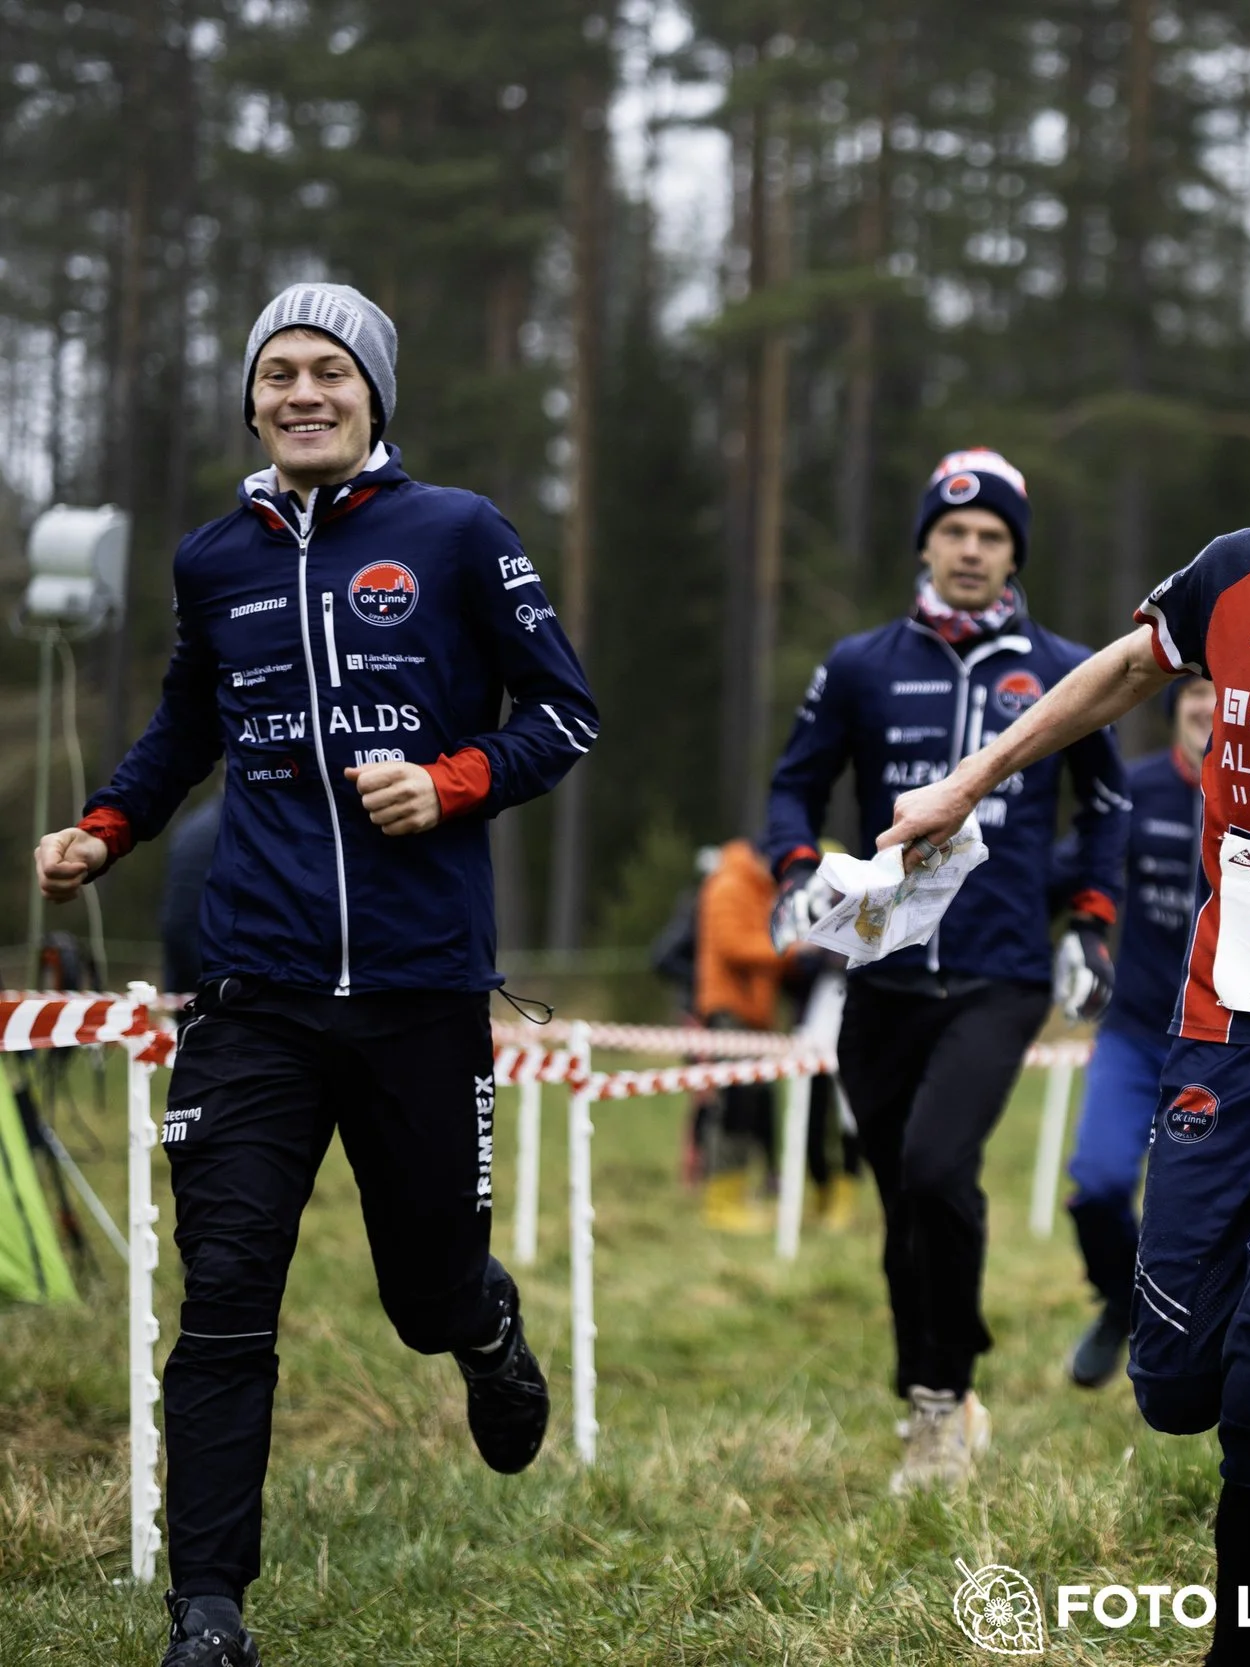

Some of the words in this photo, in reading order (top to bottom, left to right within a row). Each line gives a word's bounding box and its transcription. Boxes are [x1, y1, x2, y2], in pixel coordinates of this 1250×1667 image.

[360, 594, 376, 604] OK
[379, 594, 407, 604] Linné
[230, 597, 288, 619] noname
[368, 612, 399, 622] UPPSALA
[247, 768, 293, 781] LIVELOX
[1172, 1113, 1184, 1122] OK
[1183, 1114, 1207, 1125] Linné
[474, 1074, 495, 1213] TRIMTEX
